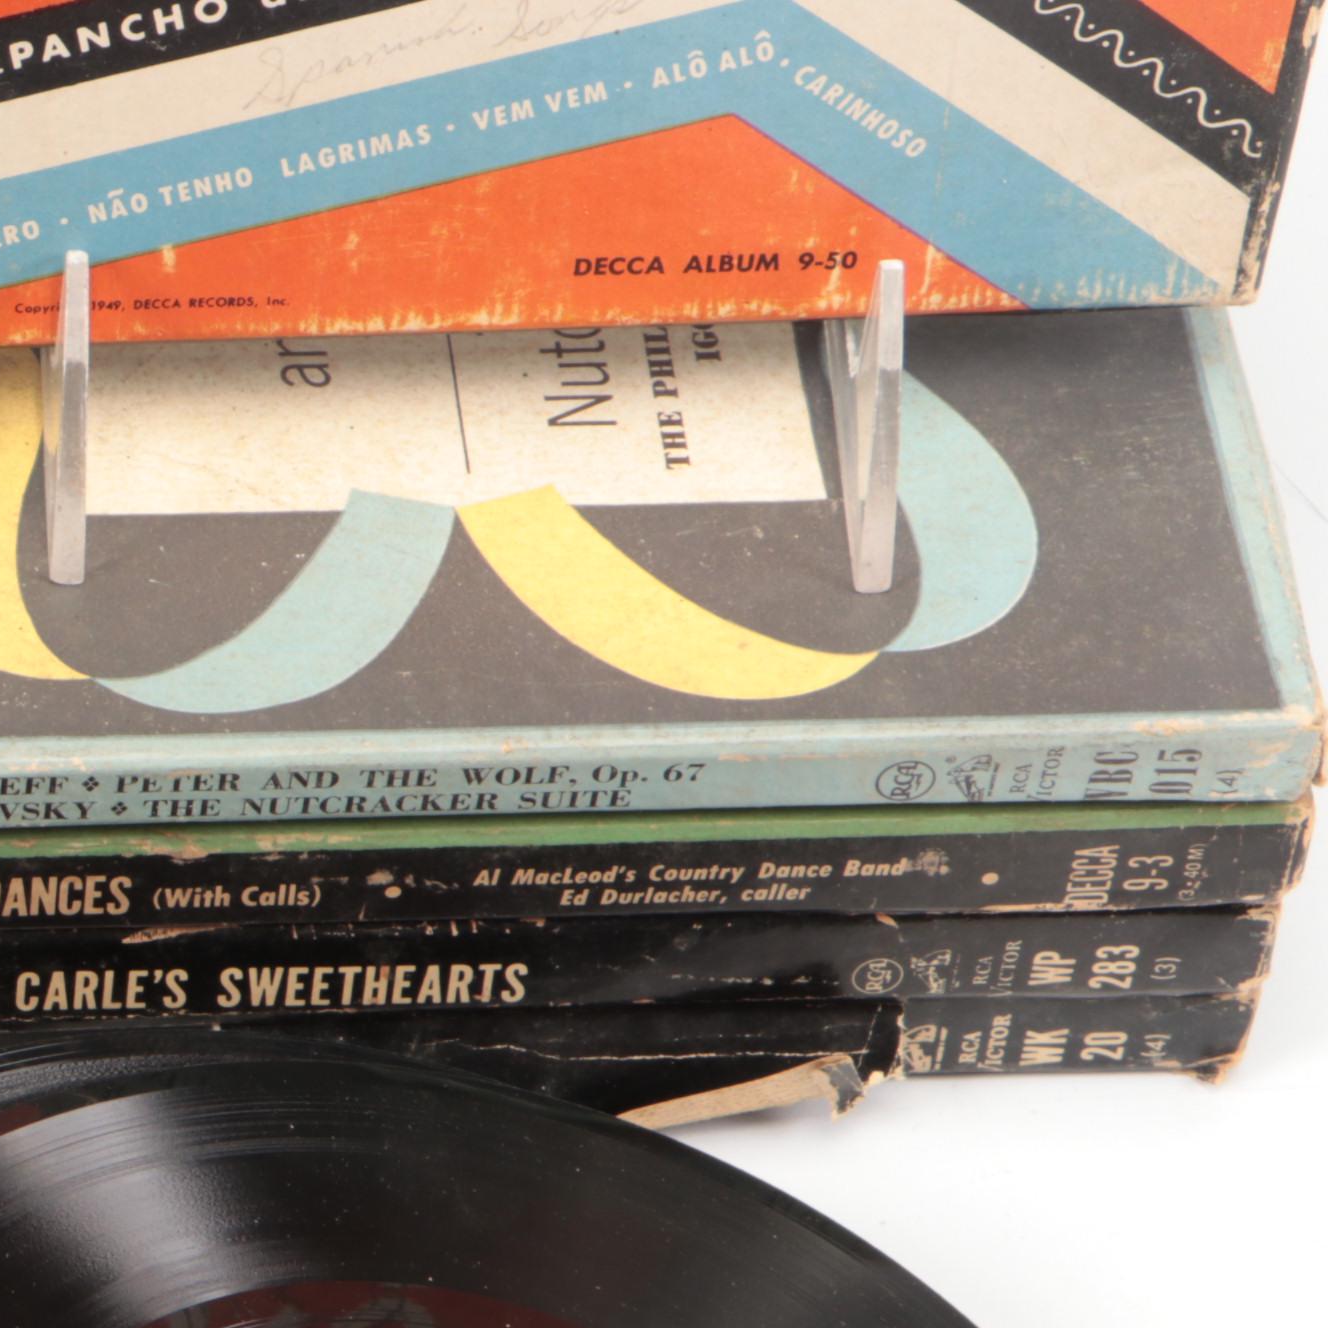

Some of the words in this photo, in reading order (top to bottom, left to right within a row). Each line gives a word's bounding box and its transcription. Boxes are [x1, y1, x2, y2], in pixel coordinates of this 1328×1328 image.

[8, 0, 228, 70] PANCHO
[87, 187, 150, 224] NÃO
[158, 167, 255, 207] TENHO
[280, 124, 433, 178] LAGRIMAS
[472, 99, 535, 131] VEM
[544, 81, 608, 114] VEM
[651, 49, 709, 89] ALÔ
[793, 65, 928, 159] CARINHOSO
[573, 256, 665, 277] DECCA
[684, 253, 779, 274] ALBUM
[798, 250, 858, 270] 9-50
[133, 298, 182, 310] DECCA
[189, 296, 259, 309] RECORDS,
[657, 411, 691, 470] THE
[115, 772, 241, 795] PETER
[263, 769, 340, 790] AND
[359, 767, 438, 789] THE
[462, 765, 578, 788] WOLF,
[592, 763, 648, 787] Op.
[662, 762, 707, 784] 67
[1009, 763, 1033, 794] RCA
[143, 796, 222, 818] THE
[240, 792, 499, 818] NUTCRACKER
[517, 788, 632, 810] SUITE
[473, 869, 499, 888] Al
[511, 865, 637, 886] MacLeod's
[648, 863, 745, 886] Country
[758, 860, 833, 880] Dance
[843, 857, 908, 878] Band
[1061, 845, 1121, 907] DECCA
[1122, 854, 1174, 891] 9-3
[153, 886, 231, 911] (With
[241, 885, 322, 909] Calls)
[559, 888, 588, 907] Ed
[600, 886, 728, 907] Durlacher,
[741, 883, 812, 902] caller
[972, 955, 994, 985] RCA
[987, 939, 1023, 998] VICTOR
[1027, 950, 1077, 986] WP
[1087, 944, 1141, 990] 283
[1150, 956, 1182, 980] (3)
[15, 969, 190, 1012] CARLE'S
[217, 963, 529, 1007] SWEETHEARTS
[958, 1031, 983, 1064] RCA
[976, 1013, 1013, 1072] VICTOR
[1018, 1027, 1070, 1067] WK
[1080, 1031, 1129, 1062] 20
[1140, 1033, 1172, 1058] (4)
